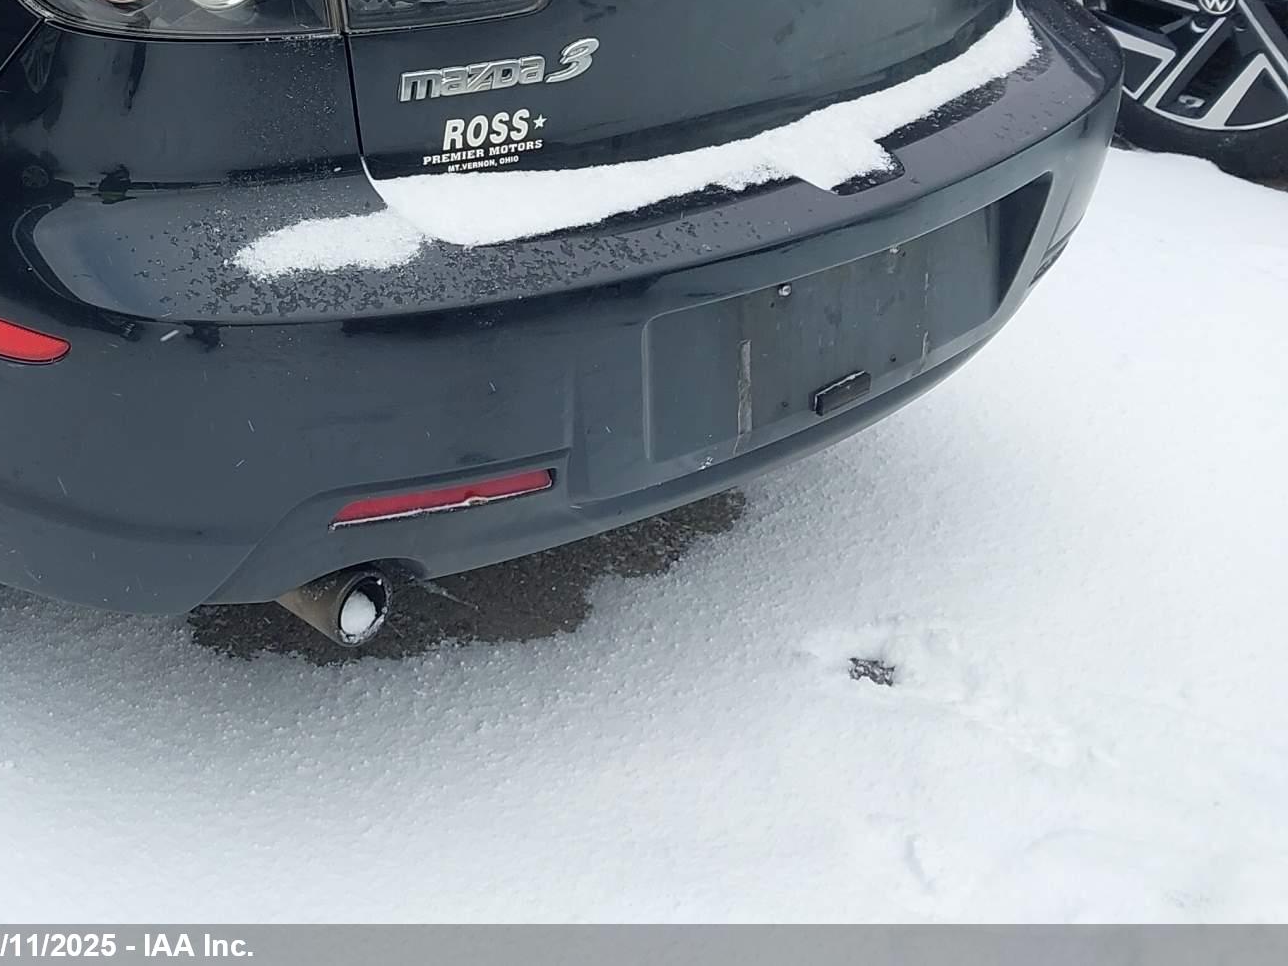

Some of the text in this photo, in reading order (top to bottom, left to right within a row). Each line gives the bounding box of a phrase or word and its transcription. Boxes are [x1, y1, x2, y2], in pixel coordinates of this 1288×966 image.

[545, 37, 600, 83] 3
[442, 108, 530, 151] ROSS
[423, 139, 543, 166] PREMIER MOTORS
[499, 155, 519, 165] OHIO
